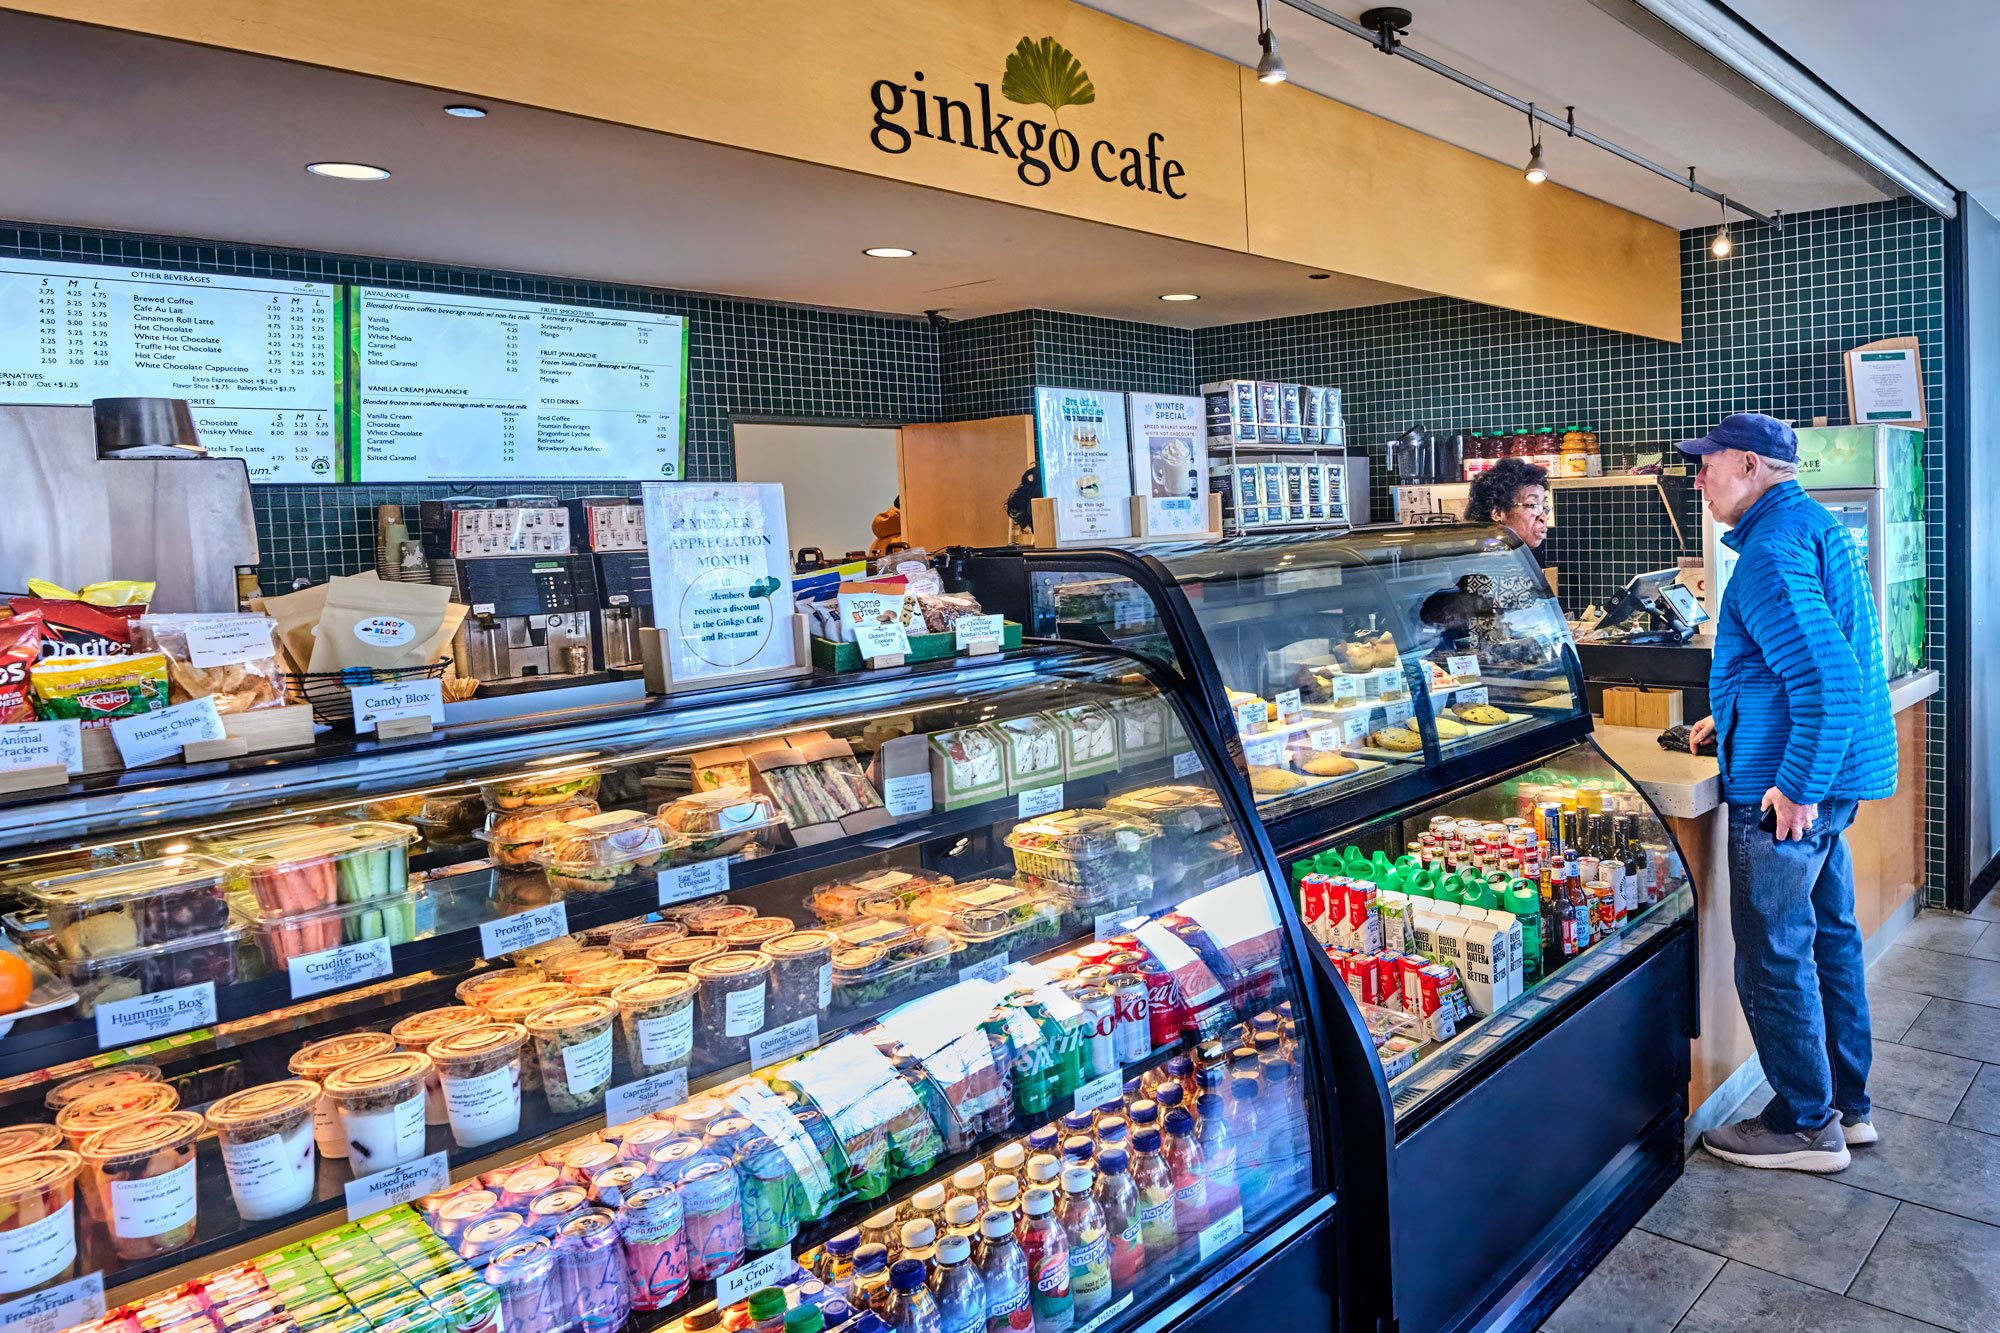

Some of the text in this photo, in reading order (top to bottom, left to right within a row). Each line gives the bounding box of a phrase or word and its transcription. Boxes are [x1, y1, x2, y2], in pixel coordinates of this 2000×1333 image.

[871, 71, 1188, 200] ginkgo cafe
[131, 271, 211, 283] OTHER BEVERAGES
[134, 295, 194, 305] Brewed Coffee
[364, 291, 411, 300] JAVALANCHE
[134, 314, 174, 323] Cinnamon
[560, 309, 595, 317] SMOOTHIES
[368, 316, 390, 324] Vanilla
[153, 325, 193, 333] Chocolate
[134, 333, 160, 341] White
[180, 336, 220, 344] Chocolate
[183, 346, 222, 354] Chocolate
[163, 363, 203, 371] Chocolate
[205, 365, 249, 373] Cappuccino
[1155, 402, 1185, 411] WINTER
[1156, 411, 1187, 420] SPECIAL
[671, 535, 772, 550] APPRECIATION
[697, 554, 750, 568] MONTH
[695, 606, 721, 616] receive
[729, 603, 760, 612] discount
[852, 599, 881, 609] home
[860, 608, 881, 617] free
[372, 620, 405, 628] CANDY
[693, 615, 764, 630] in the Ginkgo Cafe
[702, 629, 759, 642] and Restaurant
[80, 694, 127, 708] Keebler
[365, 693, 431, 709] Candy Blox
[134, 716, 201, 741] House Chips
[1, 733, 42, 745] Animal
[1027, 795, 1042, 803] Turkey
[677, 869, 711, 884] Egg Salad
[678, 877, 712, 890] Croissant
[495, 921, 533, 938] Protein
[535, 916, 553, 926] Box
[1438, 935, 1457, 948] BOXED
[1466, 941, 1485, 955] BOXED
[1492, 940, 1504, 955] BOXED
[1438, 946, 1458, 958] WATER
[1493, 950, 1506, 966] WATER
[306, 957, 352, 974] Crudite
[355, 951, 377, 962] Box
[1467, 953, 1486, 965] WATER
[1467, 961, 1473, 971] IS
[1493, 964, 1498, 974] IS
[1467, 971, 1491, 985] BETTER.
[112, 1004, 174, 1025] Hummus
[178, 999, 203, 1010] Box
[760, 1026, 811, 1050] Quinoa Salad
[622, 1077, 674, 1101] Caprese Pasta
[1081, 1082, 1117, 1102] Canned Soda
[638, 1090, 659, 1102] Salad
[369, 1168, 429, 1193] Mixed Berry
[384, 1180, 416, 1196] Parfait
[1213, 1224, 1234, 1243] Snapple
[730, 1262, 775, 1291] La Croix
[836, 1266, 852, 1277] LIGHT
[744, 1280, 762, 1294] $ 1.99
[4, 1293, 76, 1324] Fresh Fruit
[25, 1309, 59, 1330] Salad
